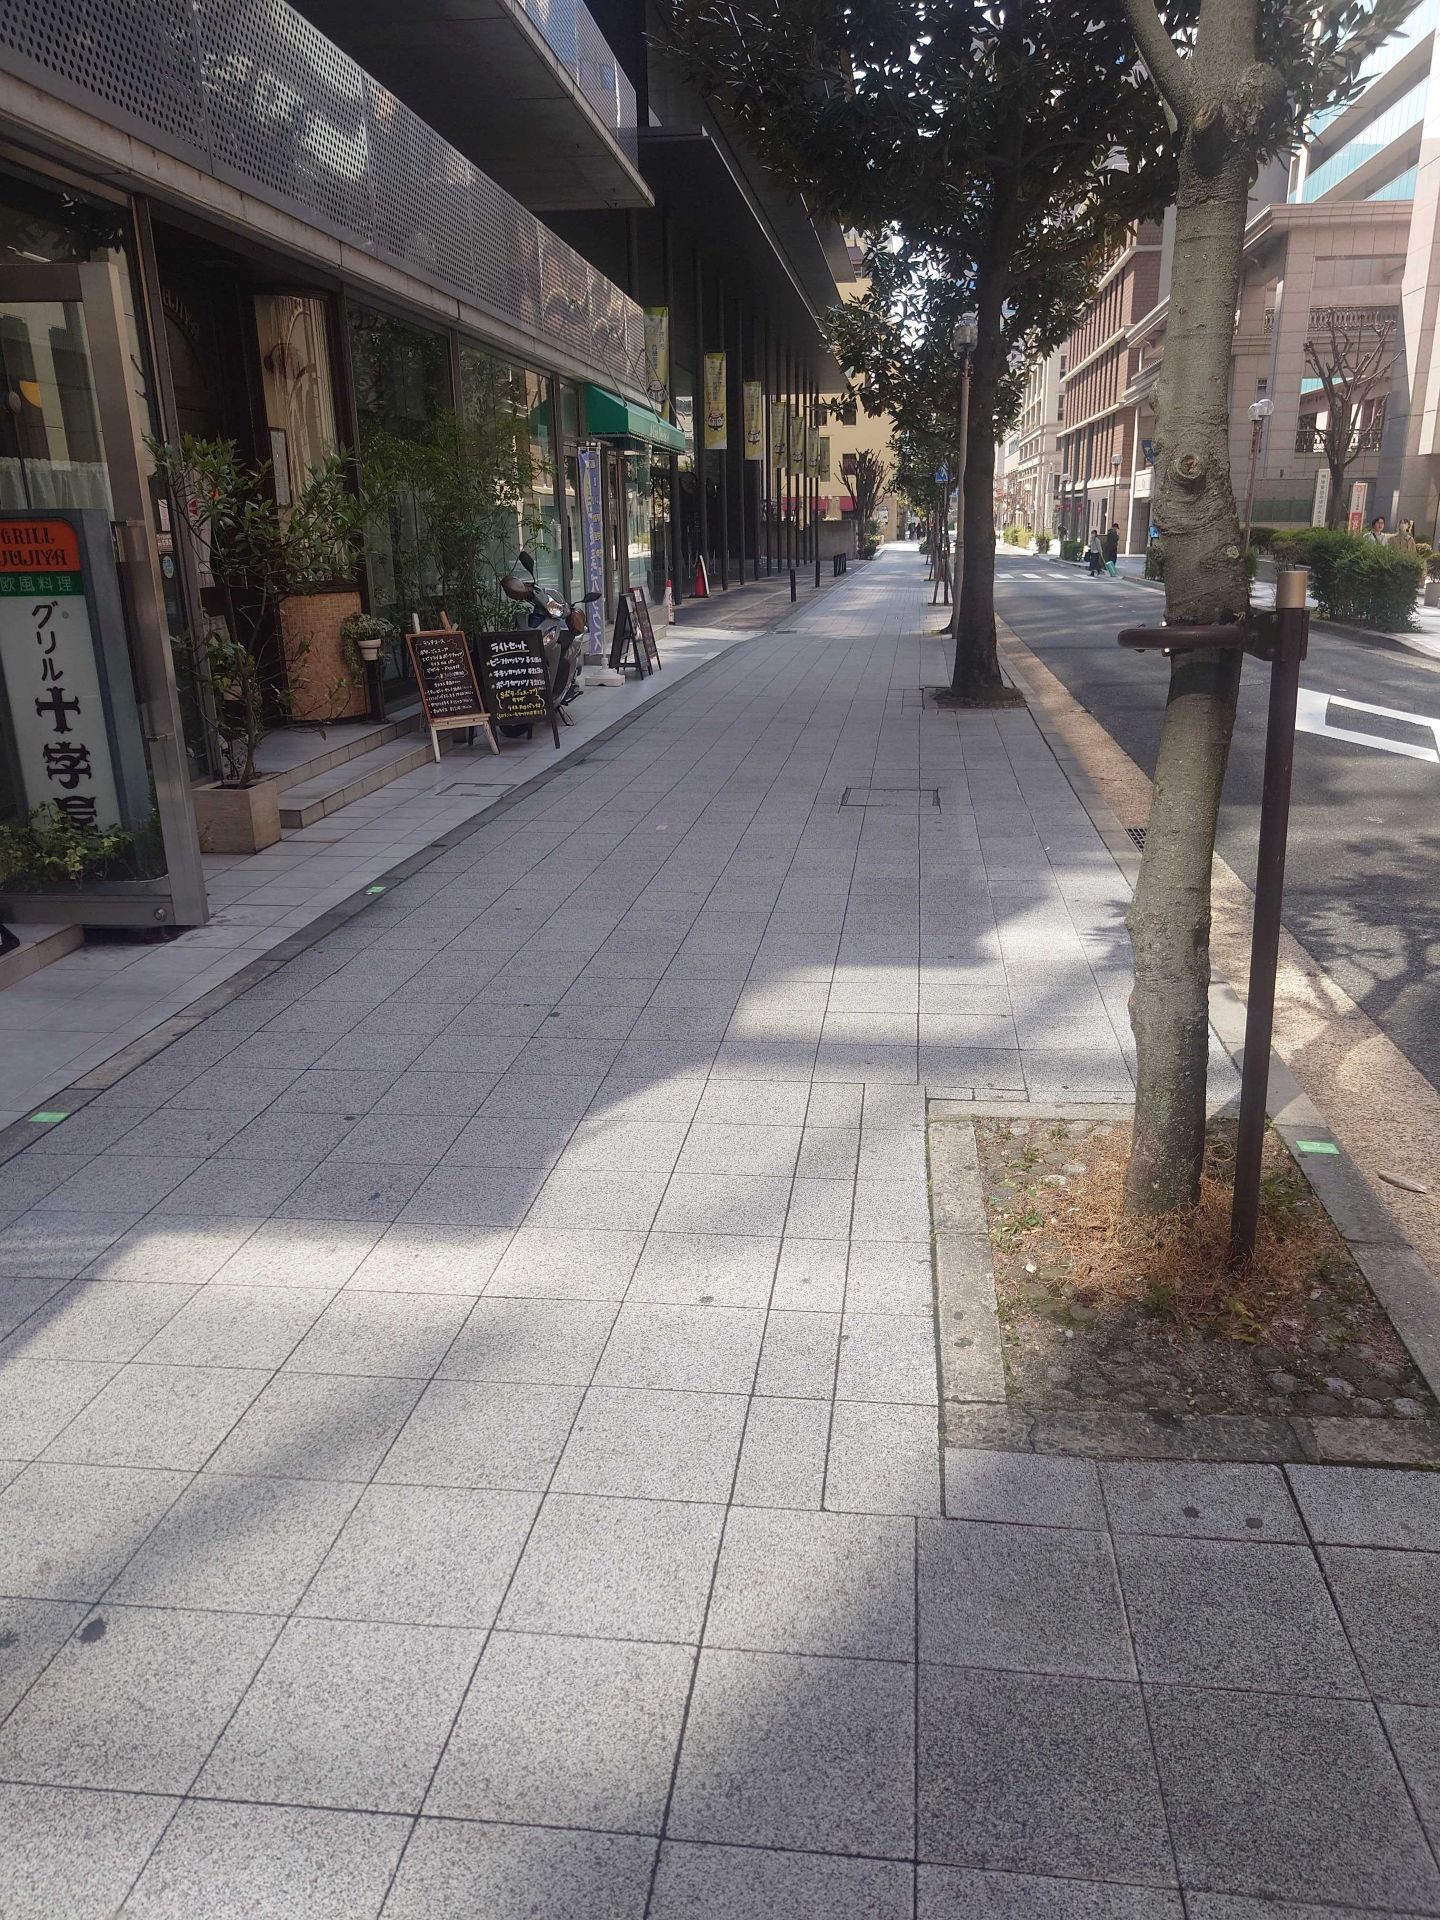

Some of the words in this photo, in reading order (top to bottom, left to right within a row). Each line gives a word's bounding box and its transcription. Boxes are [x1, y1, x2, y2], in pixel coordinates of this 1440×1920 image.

[1, 527, 56, 545] GRILL
[0, 548, 68, 567] JUJIYA
[0, 575, 73, 592] 欧風料理
[490, 640, 528, 653] ライトセット
